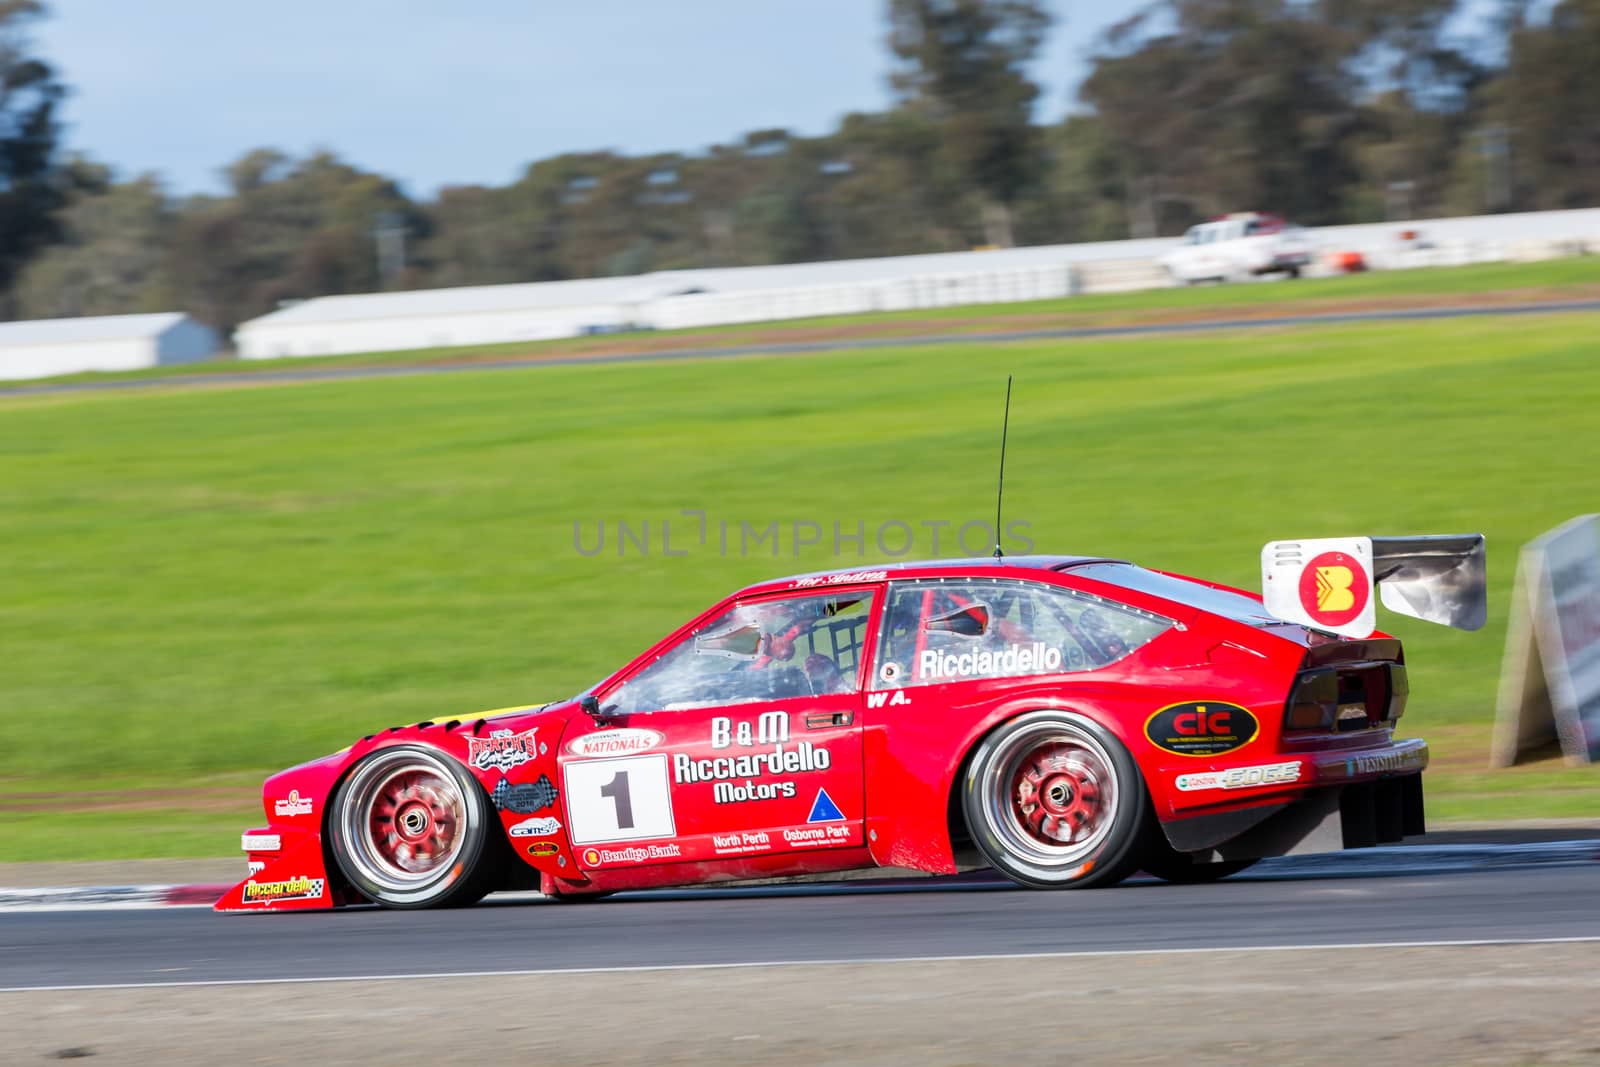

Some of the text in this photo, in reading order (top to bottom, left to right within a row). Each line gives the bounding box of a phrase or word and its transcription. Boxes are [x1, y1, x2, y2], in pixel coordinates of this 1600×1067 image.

[920, 641, 1061, 678] Ricciardello
[711, 711, 790, 749] B & M
[583, 737, 651, 754] NATIONALS
[673, 741, 831, 784] Ricciardello
[1222, 762, 1301, 787] EDGE
[600, 771, 634, 829] 1
[713, 780, 797, 804] Motors
[713, 832, 770, 848] North Perth
[783, 825, 851, 842] Osborne Park
[601, 848, 648, 862] Bendigo
[648, 843, 681, 858] Bank
